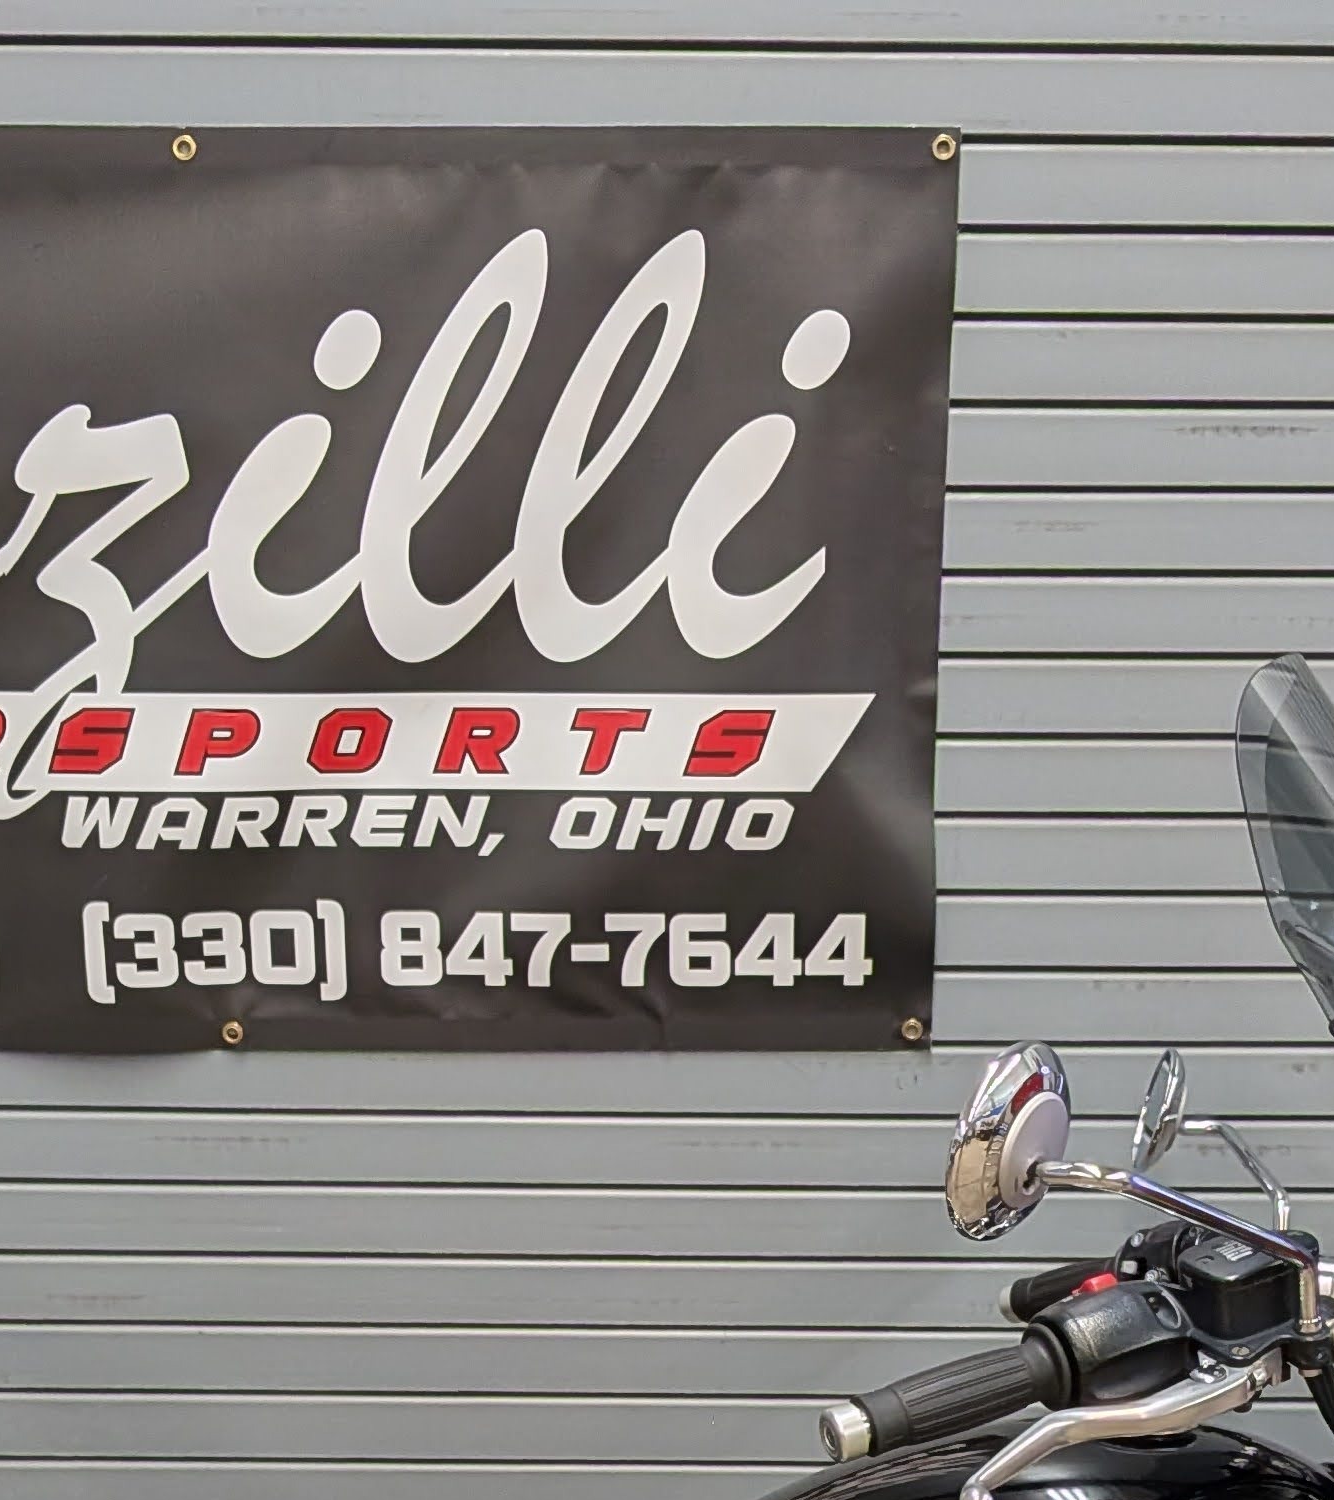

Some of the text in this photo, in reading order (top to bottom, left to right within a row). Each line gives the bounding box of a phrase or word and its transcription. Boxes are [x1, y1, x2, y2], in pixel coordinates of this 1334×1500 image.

[61, 795, 793, 856] WARREN, OHIO
[82, 899, 348, 1005] (330)
[380, 911, 873, 989] 847-7644
